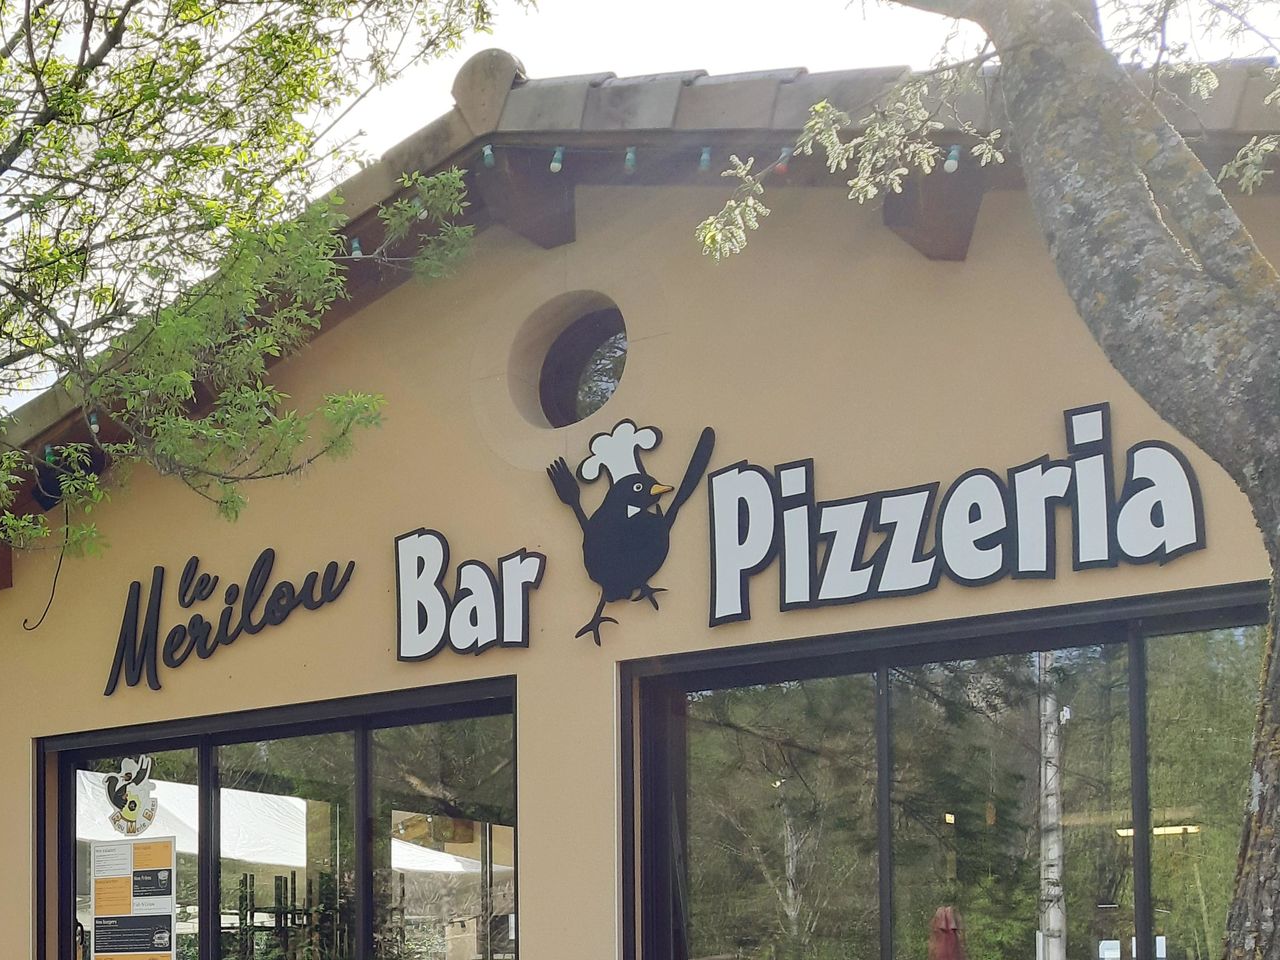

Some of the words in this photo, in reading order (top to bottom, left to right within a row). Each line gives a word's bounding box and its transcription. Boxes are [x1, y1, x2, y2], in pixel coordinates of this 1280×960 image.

[178, 555, 219, 608] le
[395, 527, 547, 662] Bar
[708, 402, 1205, 627] Pizzeria
[104, 548, 355, 696] Merilou
